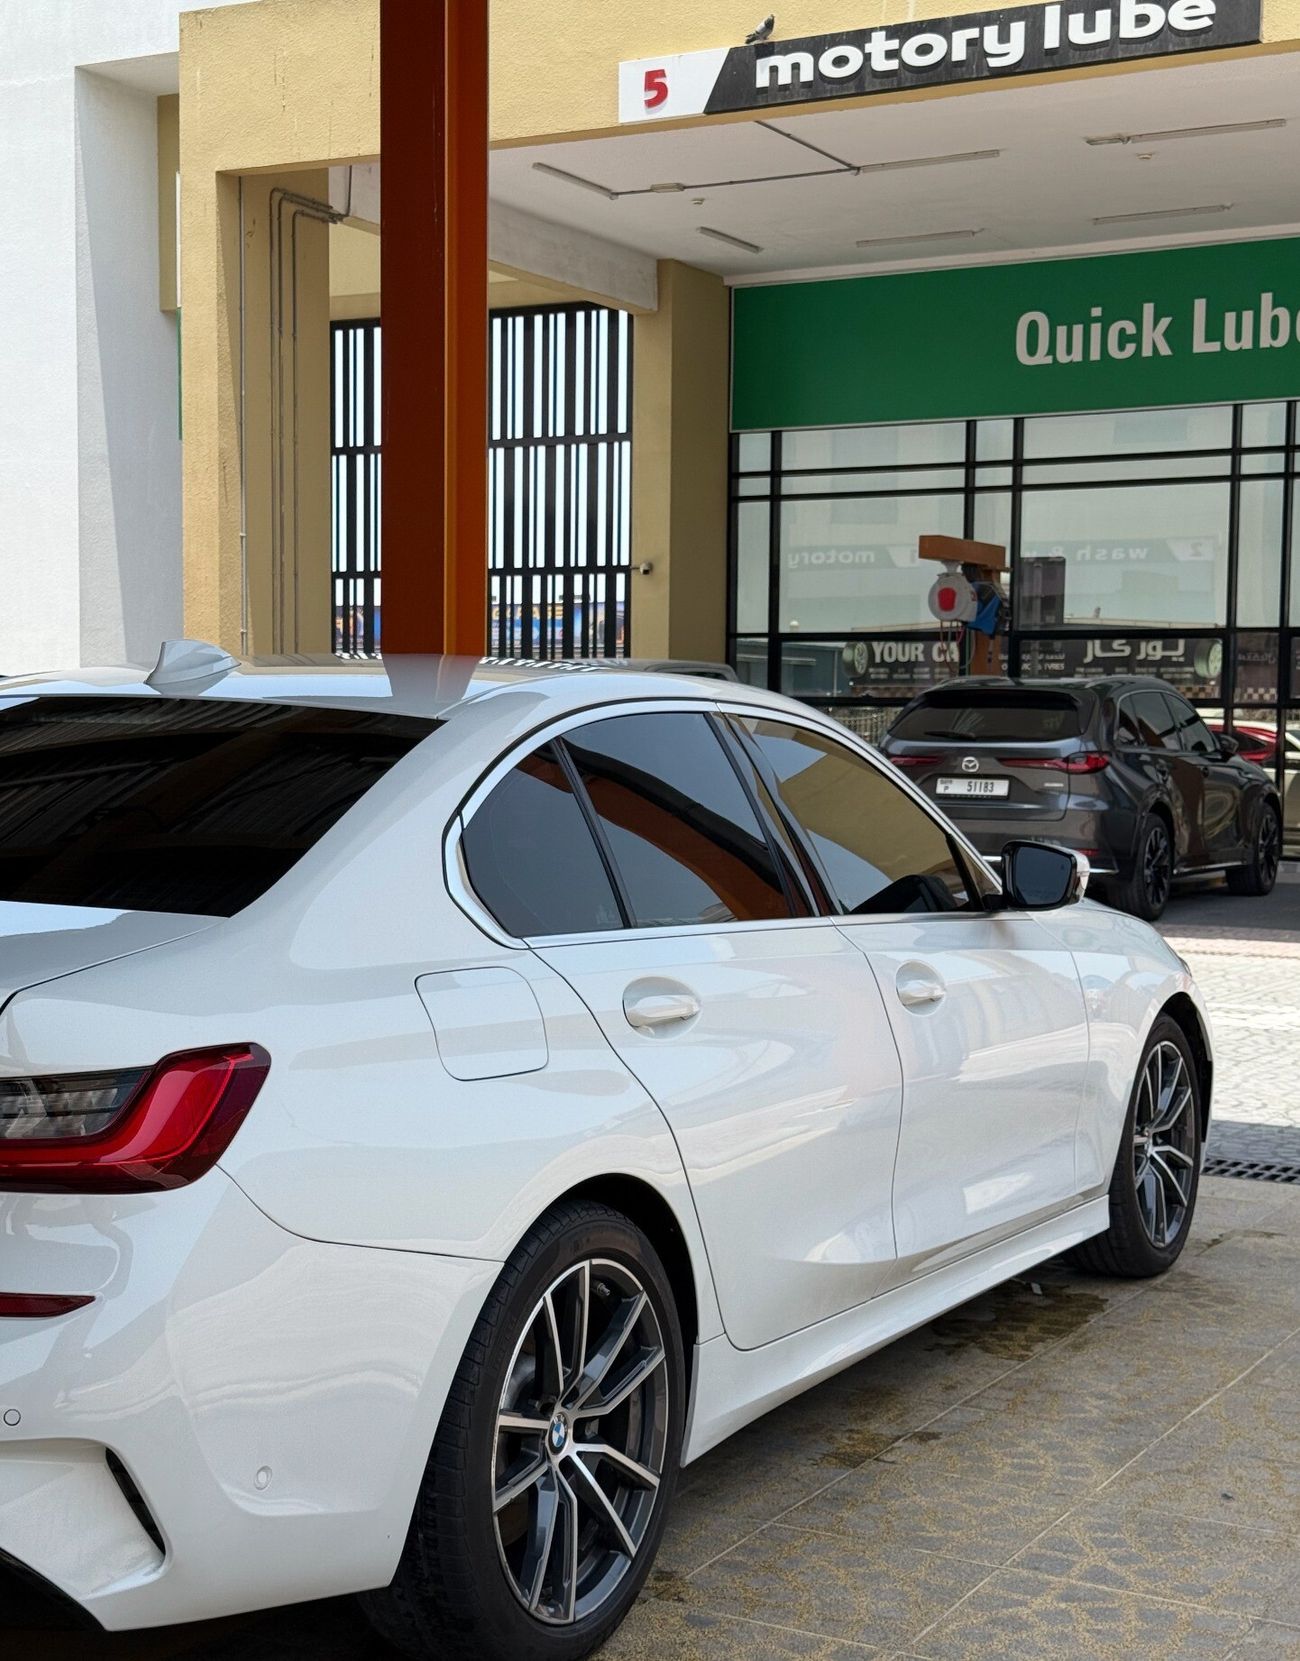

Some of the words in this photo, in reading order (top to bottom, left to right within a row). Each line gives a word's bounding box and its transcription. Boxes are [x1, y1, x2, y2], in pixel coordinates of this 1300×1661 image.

[644, 69, 668, 108] 5
[755, 21, 1026, 88] motory
[1043, 0, 1217, 50] lube
[1015, 303, 1173, 366] Quick
[1192, 292, 1300, 354] Lub
[871, 641, 925, 664] YOUR
[931, 641, 960, 663] CA
[966, 781, 995, 794] 51183
